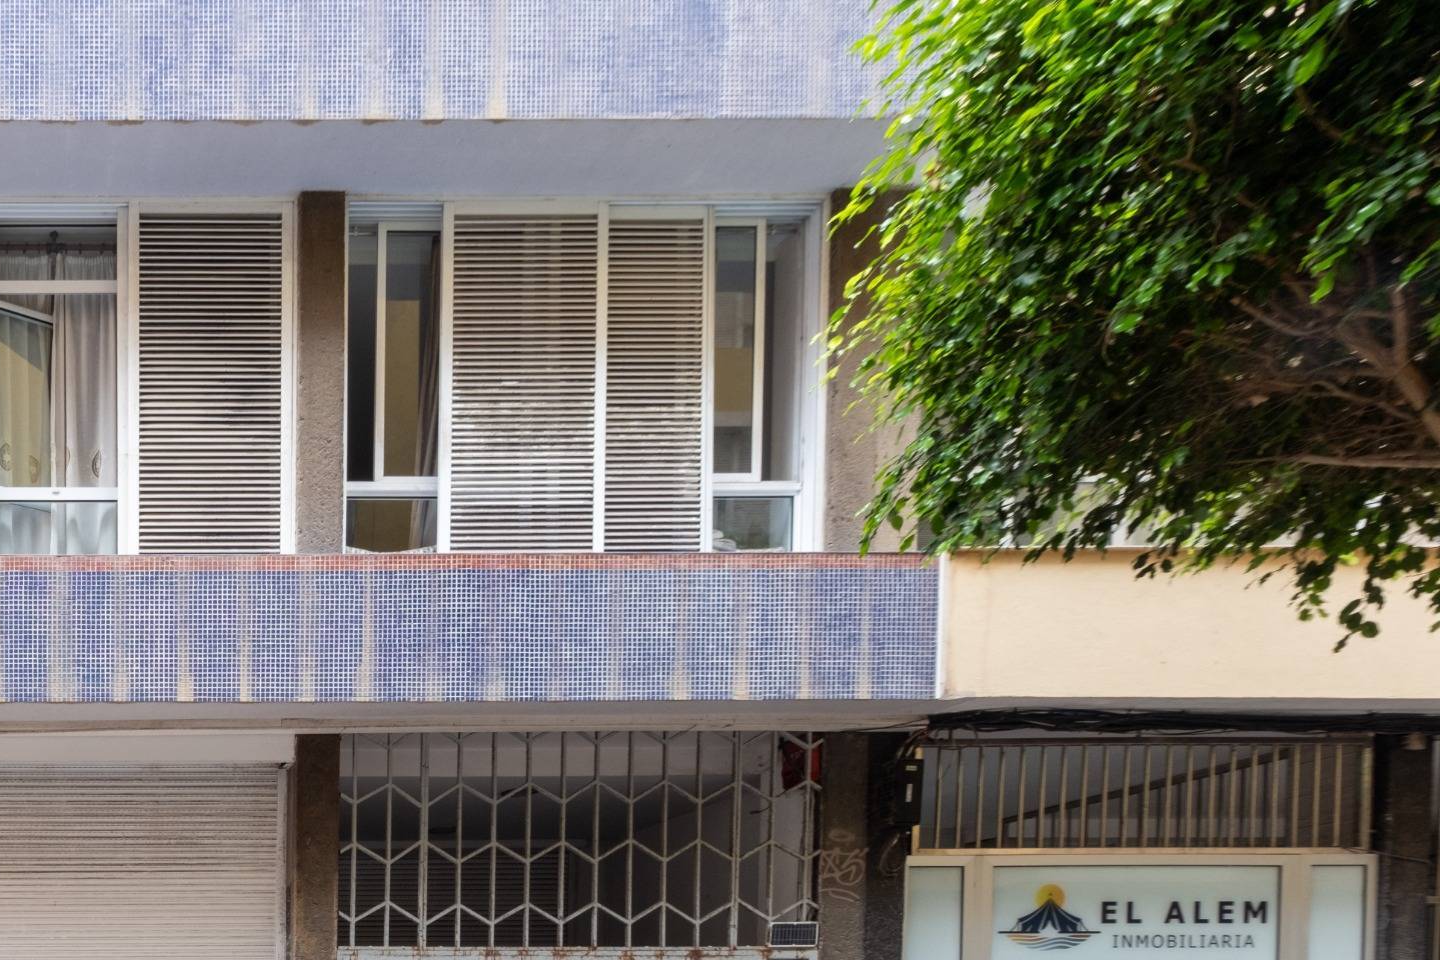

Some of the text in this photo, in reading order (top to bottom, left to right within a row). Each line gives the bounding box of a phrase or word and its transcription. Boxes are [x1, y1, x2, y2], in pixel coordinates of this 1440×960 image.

[1100, 900, 1268, 924] EL ALEM
[1111, 934, 1256, 949] INMOBILIARIA
